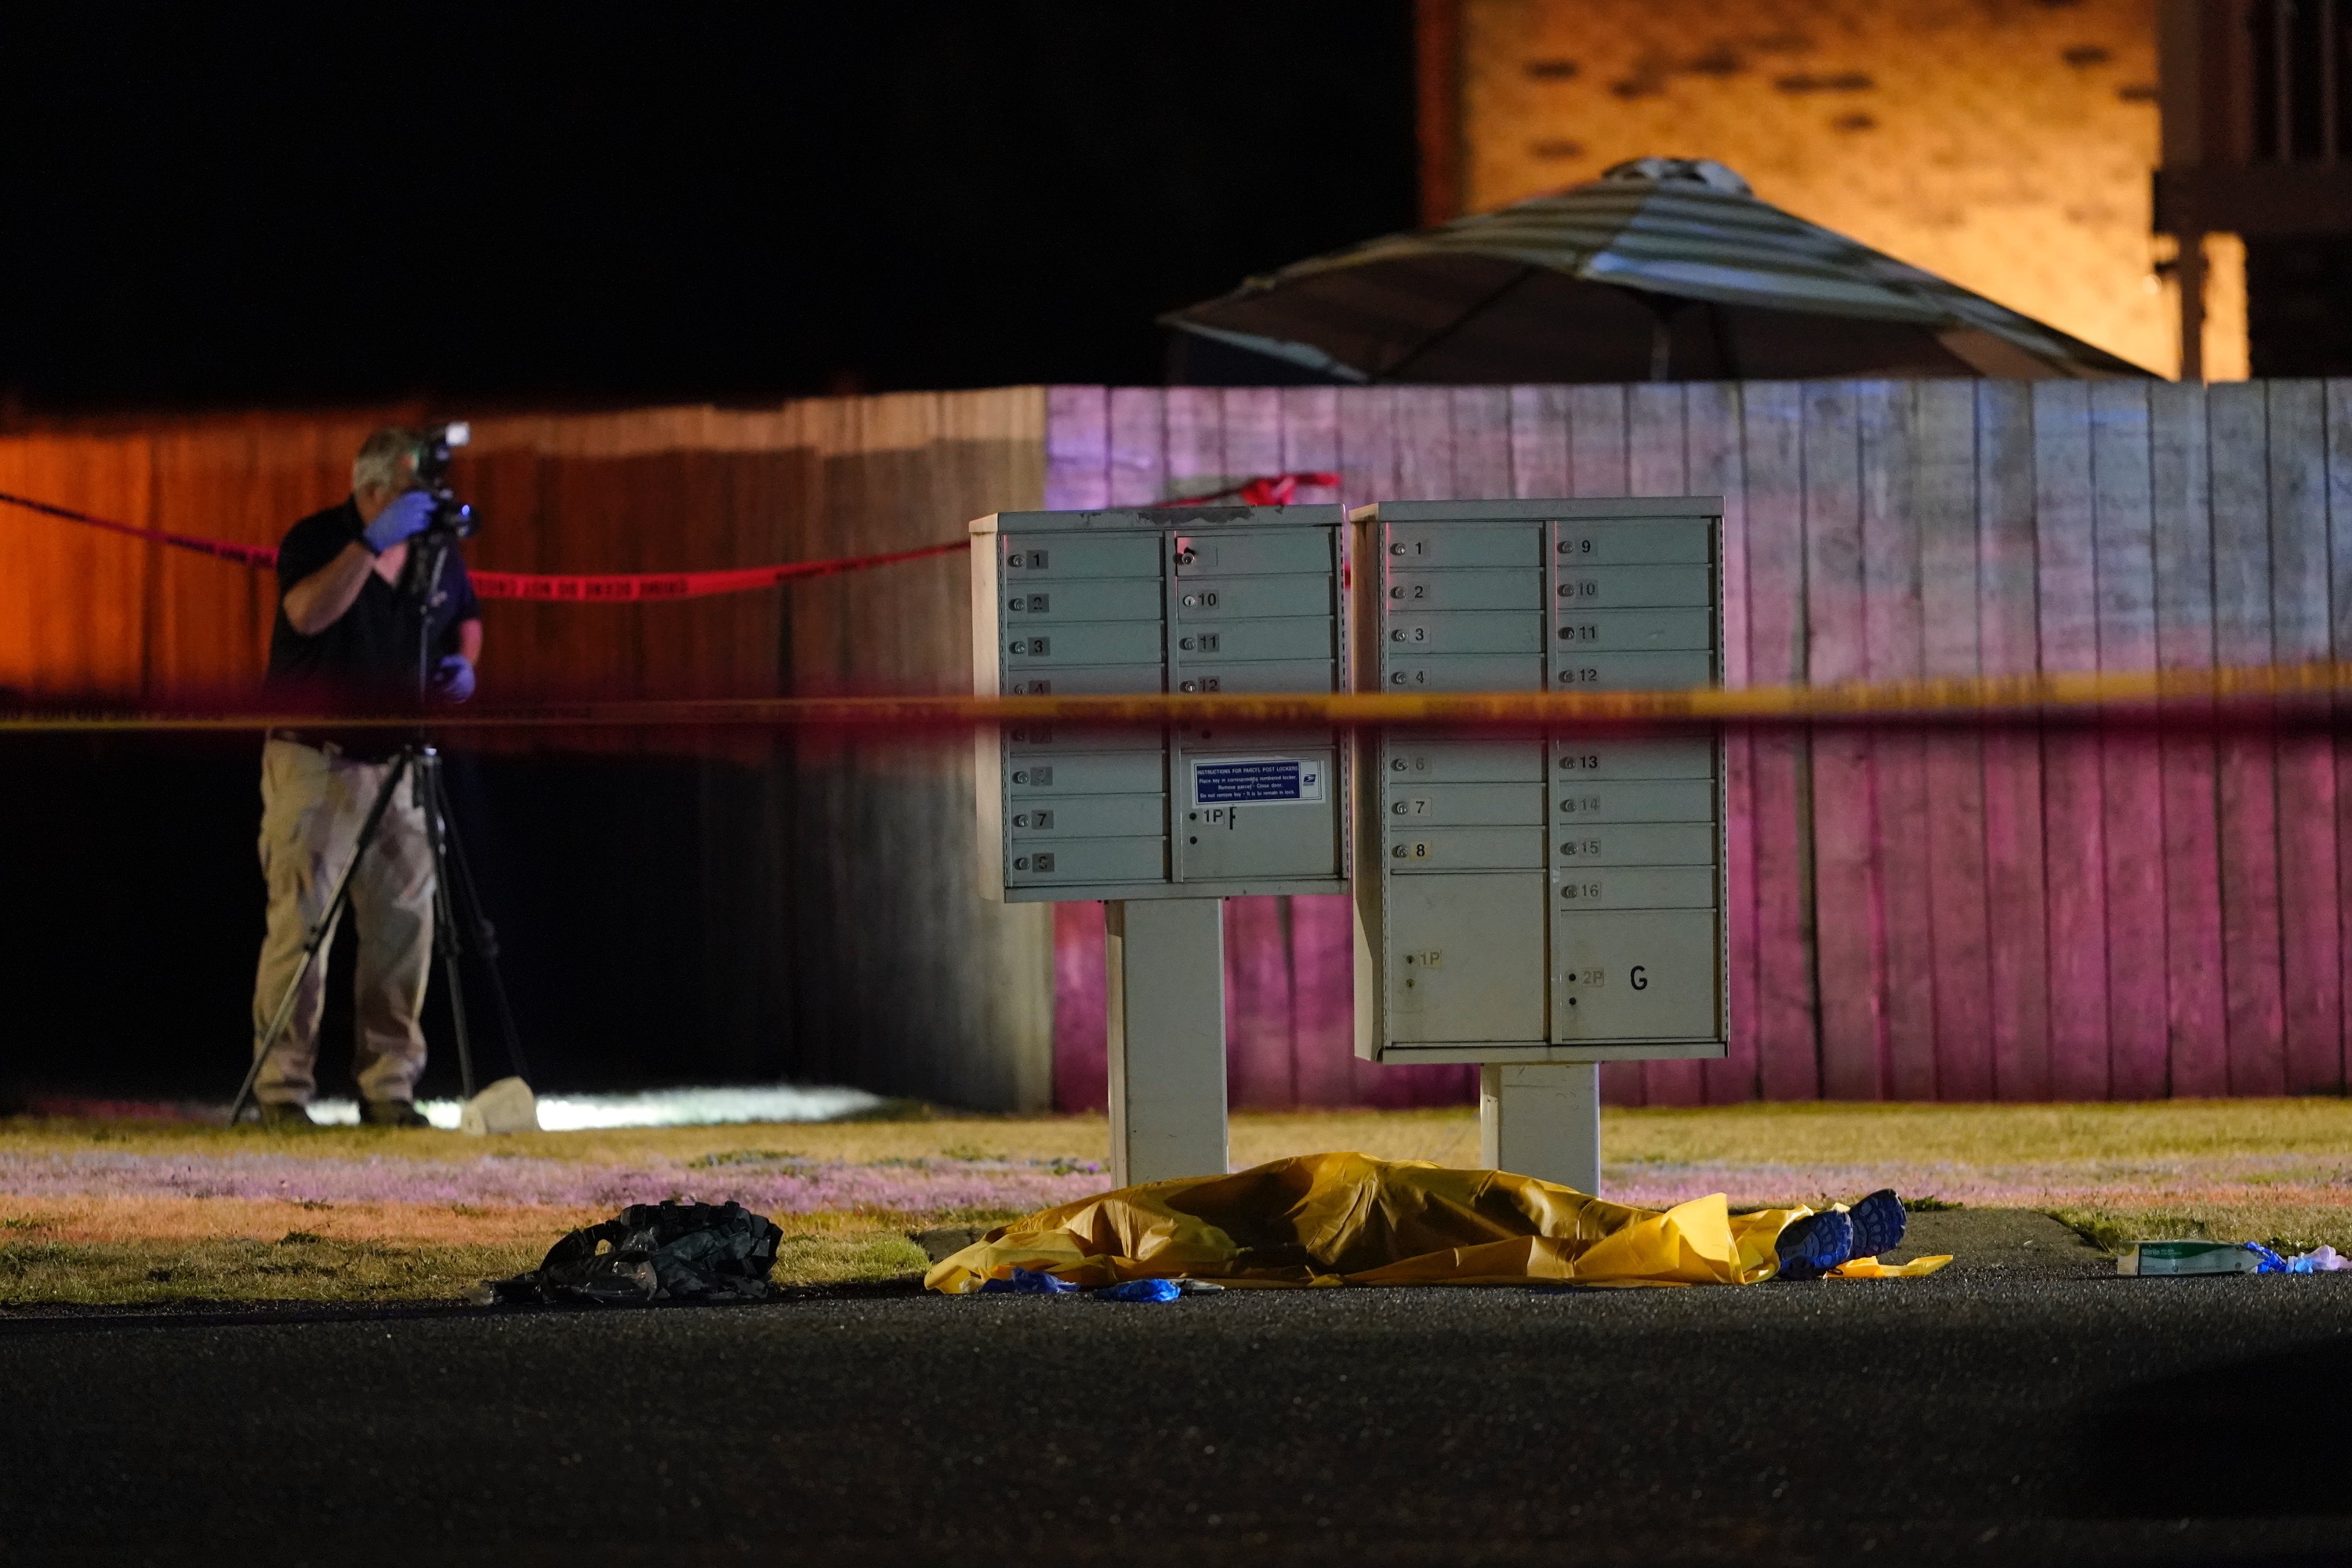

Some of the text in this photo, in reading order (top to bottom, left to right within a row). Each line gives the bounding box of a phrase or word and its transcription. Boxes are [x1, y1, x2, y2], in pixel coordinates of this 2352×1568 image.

[1415, 542, 1421, 554] 1
[1581, 540, 1591, 554] 9
[1033, 553, 1040, 567] 1
[1414, 586, 1424, 598] 2
[1579, 583, 1595, 596] 10
[1199, 593, 1217, 607] 10
[1415, 628, 1425, 641] 3
[1579, 626, 1595, 639] 11
[1034, 640, 1043, 653] 3
[1200, 635, 1216, 650] 11
[1416, 671, 1425, 684] 4
[1580, 669, 1597, 682] 12
[1200, 679, 1218, 693] 12
[1415, 757, 1425, 771] 6
[1580, 755, 1598, 768] 13
[1415, 800, 1425, 814] 7
[1581, 798, 1599, 811] 14
[1037, 813, 1047, 826] 7
[1203, 808, 1223, 822] 1P
[1416, 844, 1425, 857] 8
[1581, 840, 1599, 854] 15
[1581, 884, 1599, 898] 16
[1420, 951, 1440, 966] 1P
[1583, 970, 1603, 985] 2P
[1630, 965, 1648, 990] G
